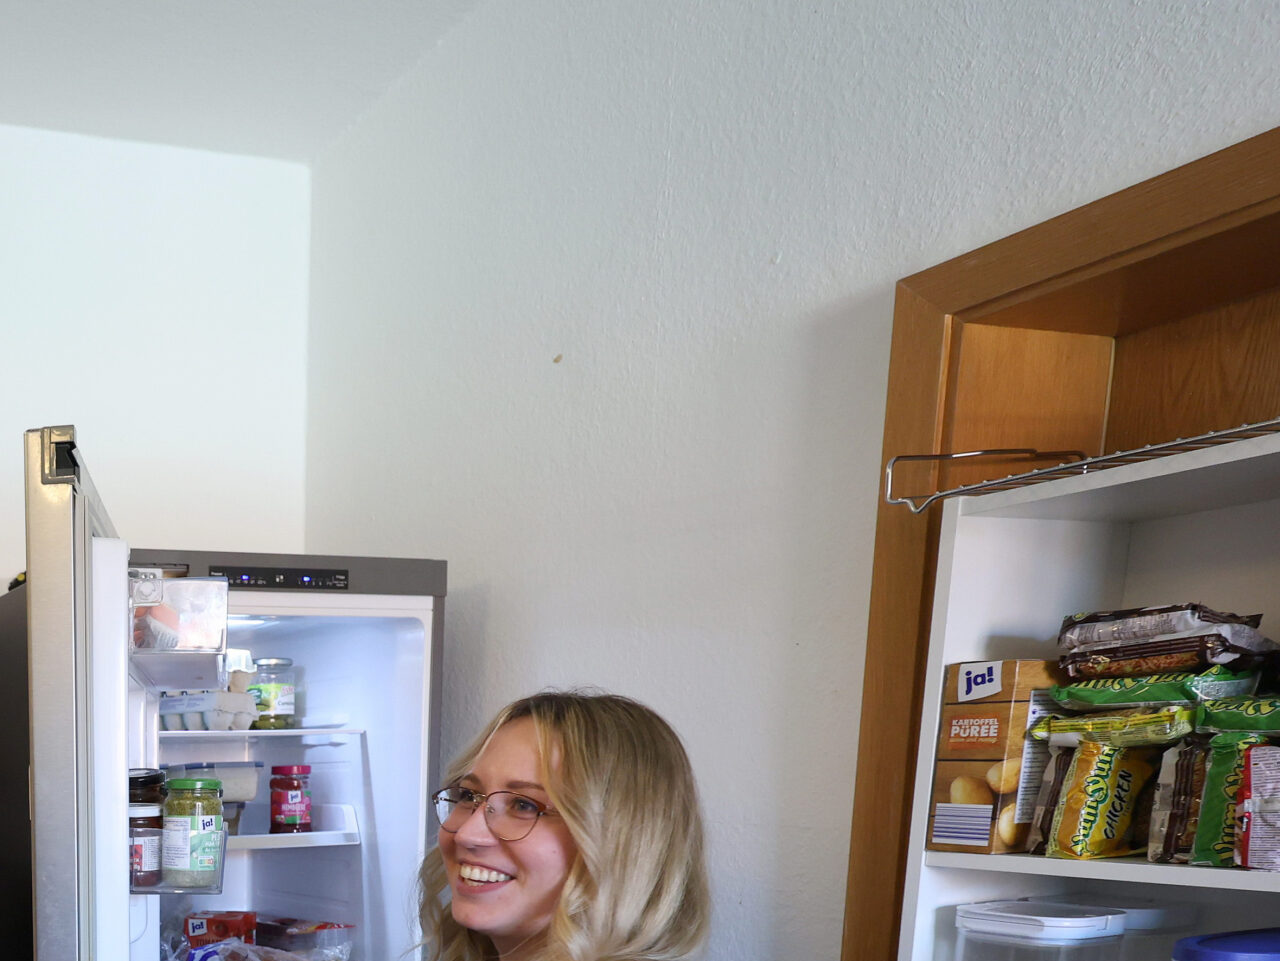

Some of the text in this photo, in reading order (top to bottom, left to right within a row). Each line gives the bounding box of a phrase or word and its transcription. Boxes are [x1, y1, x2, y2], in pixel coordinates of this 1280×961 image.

[965, 666, 995, 695] ja!
[951, 718, 1000, 726] KARTOFFEL
[950, 725, 999, 737] PÜREE
[1103, 768, 1133, 840] CHICKEN
[202, 818, 214, 830] ja!
[191, 922, 204, 933] ja!
